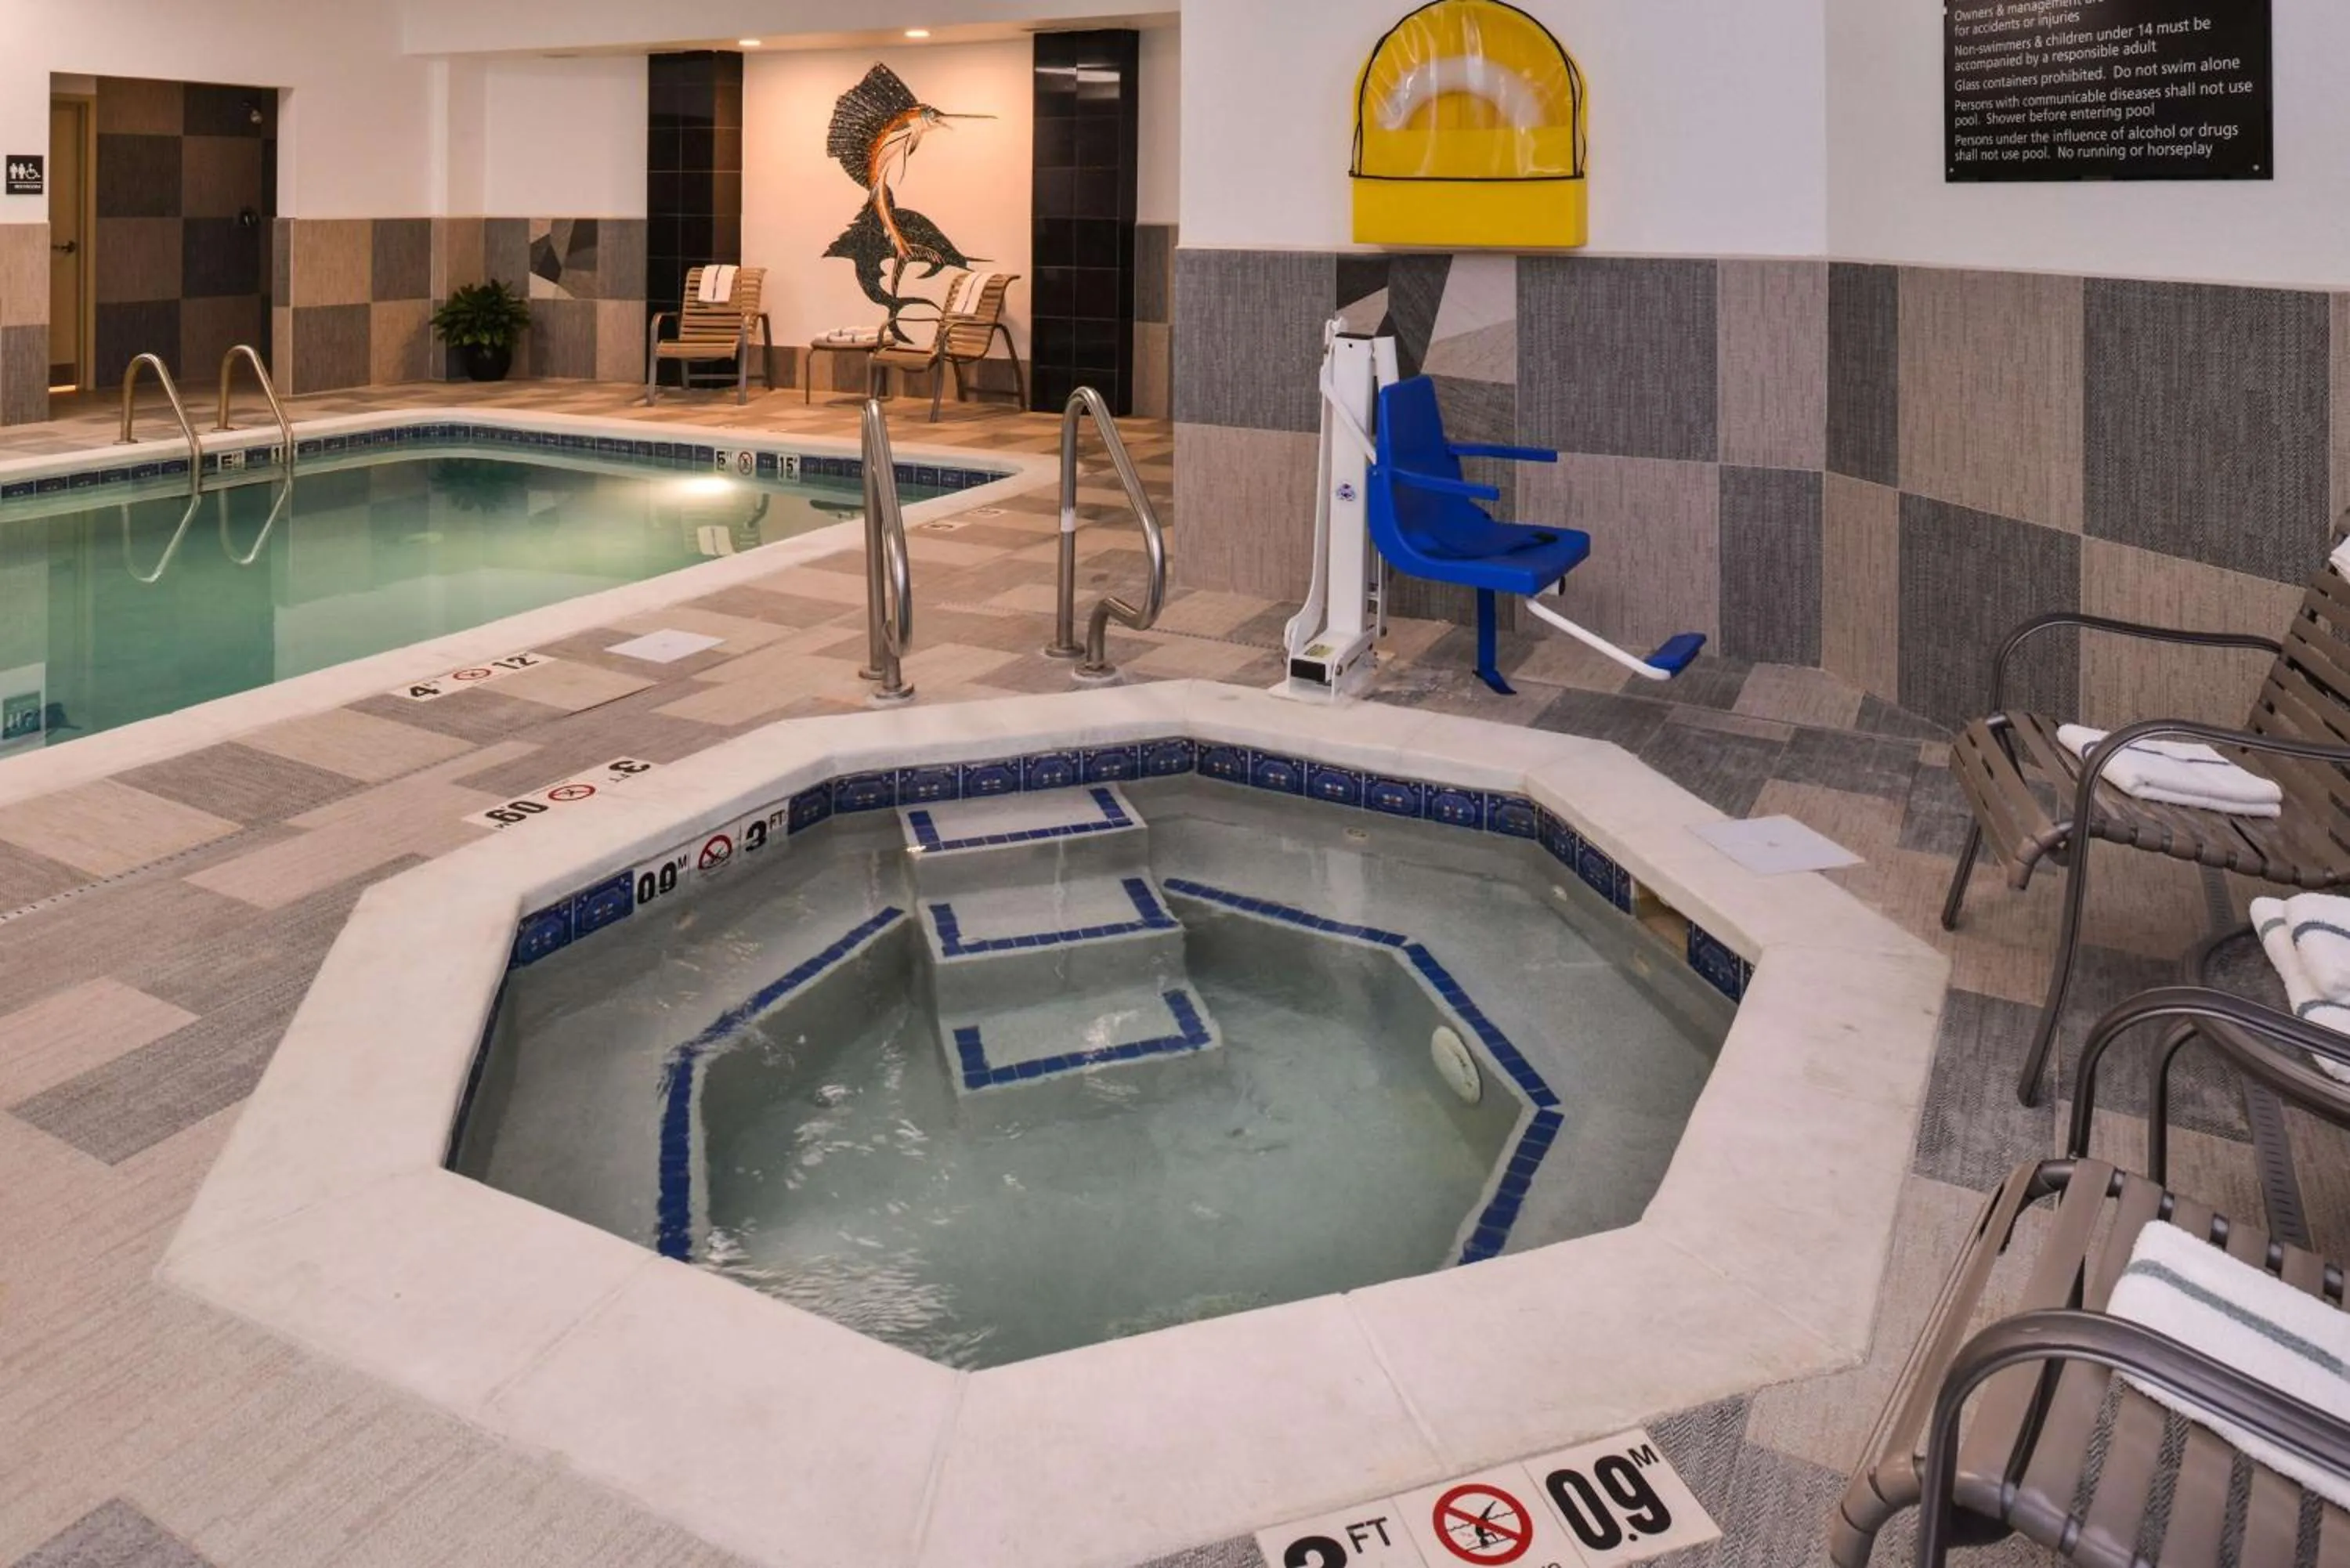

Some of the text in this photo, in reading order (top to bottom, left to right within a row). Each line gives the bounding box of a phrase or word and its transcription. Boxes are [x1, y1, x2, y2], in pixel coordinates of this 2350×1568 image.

[1954, 10, 1994, 22] Owners
[1997, 5, 2005, 16] &
[1954, 11, 2081, 37] for accidents or injuries
[1954, 16, 2212, 56] Non-swimmers & children under 14 must be
[1954, 40, 2157, 71] accompanied by a responsible adult
[1954, 56, 2240, 92] Glass containers prohibited. Do not swim alone
[1954, 81, 2254, 112] Persons with communicable diseases shall not use
[1986, 112, 2026, 125] Shower
[2030, 108, 2067, 122] before
[2070, 105, 2122, 121] entering
[2125, 103, 2155, 119] pool
[1954, 121, 2239, 146] Persons under the influence of alcohol or drugs
[1954, 148, 1978, 161] shall
[1981, 148, 1998, 161] not
[2001, 150, 2019, 160] use
[2058, 146, 2074, 157] No
[2077, 143, 2126, 161] running
[2129, 145, 2143, 157] or
[2147, 141, 2213, 159] horseplay
[410, 686, 439, 697] 4
[609, 761, 651, 774] 3
[745, 819, 767, 852] 3
[768, 810, 785, 830] FT
[1344, 1516, 1391, 1555] FT
[1627, 1443, 1660, 1469] M
